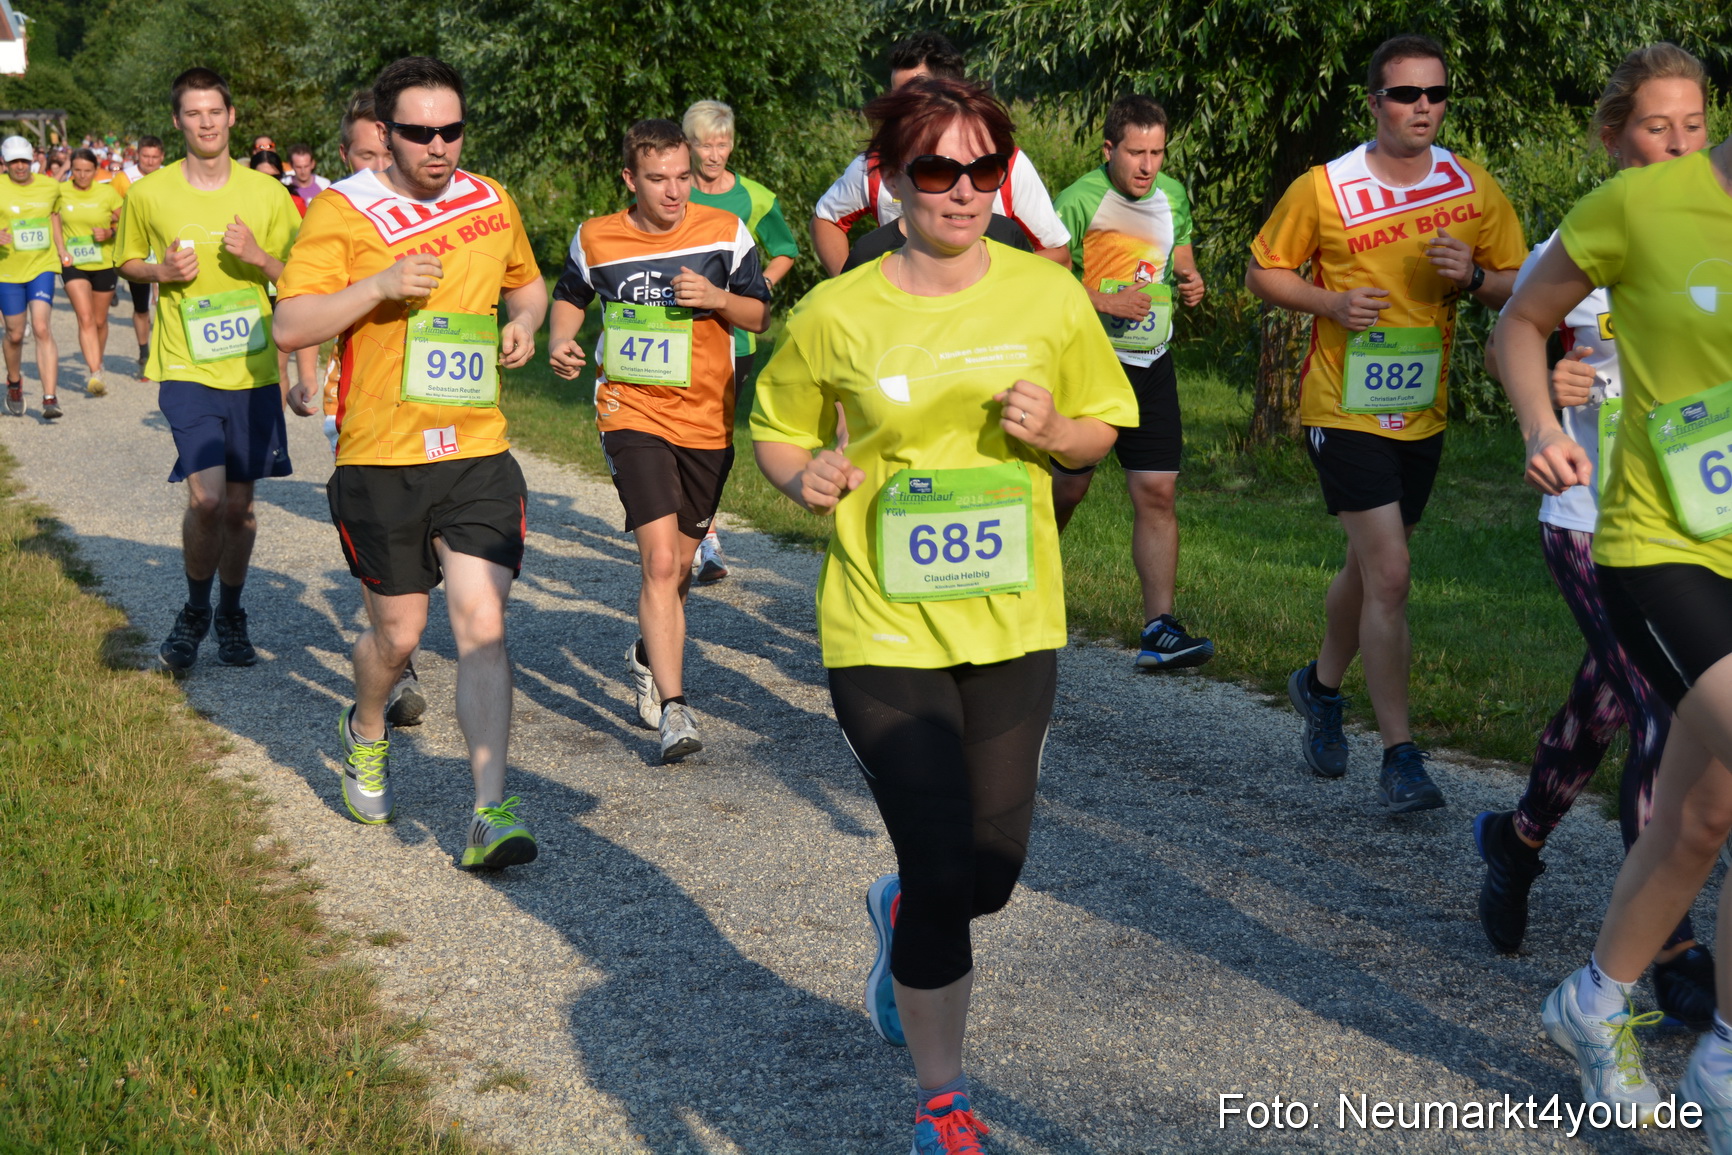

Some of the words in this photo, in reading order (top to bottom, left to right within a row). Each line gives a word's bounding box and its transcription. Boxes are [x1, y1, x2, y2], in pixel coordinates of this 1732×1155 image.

[21, 231, 44, 243] 678
[456, 213, 511, 244] BÖGL
[1347, 223, 1409, 255] MAX
[1415, 203, 1482, 234] BÖGL
[73, 247, 95, 257] 664
[203, 317, 250, 343] 650
[620, 336, 669, 363] 471
[939, 349, 972, 360] Kliniken
[965, 354, 1004, 364] Neumarkt
[427, 350, 484, 381] 930
[620, 366, 643, 374] Christian
[644, 367, 672, 375] Henninger
[1364, 362, 1424, 390] 882
[428, 385, 458, 393] Sebastian
[1675, 408, 1731, 436] firmenlauf
[1698, 443, 1732, 495] 6
[900, 491, 954, 502] firmenlauf
[955, 495, 984, 505] 2015
[1716, 506, 1731, 515] Dr.
[909, 519, 1003, 565] 685
[924, 572, 960, 582] Claudia
[961, 570, 990, 580] Helbig
